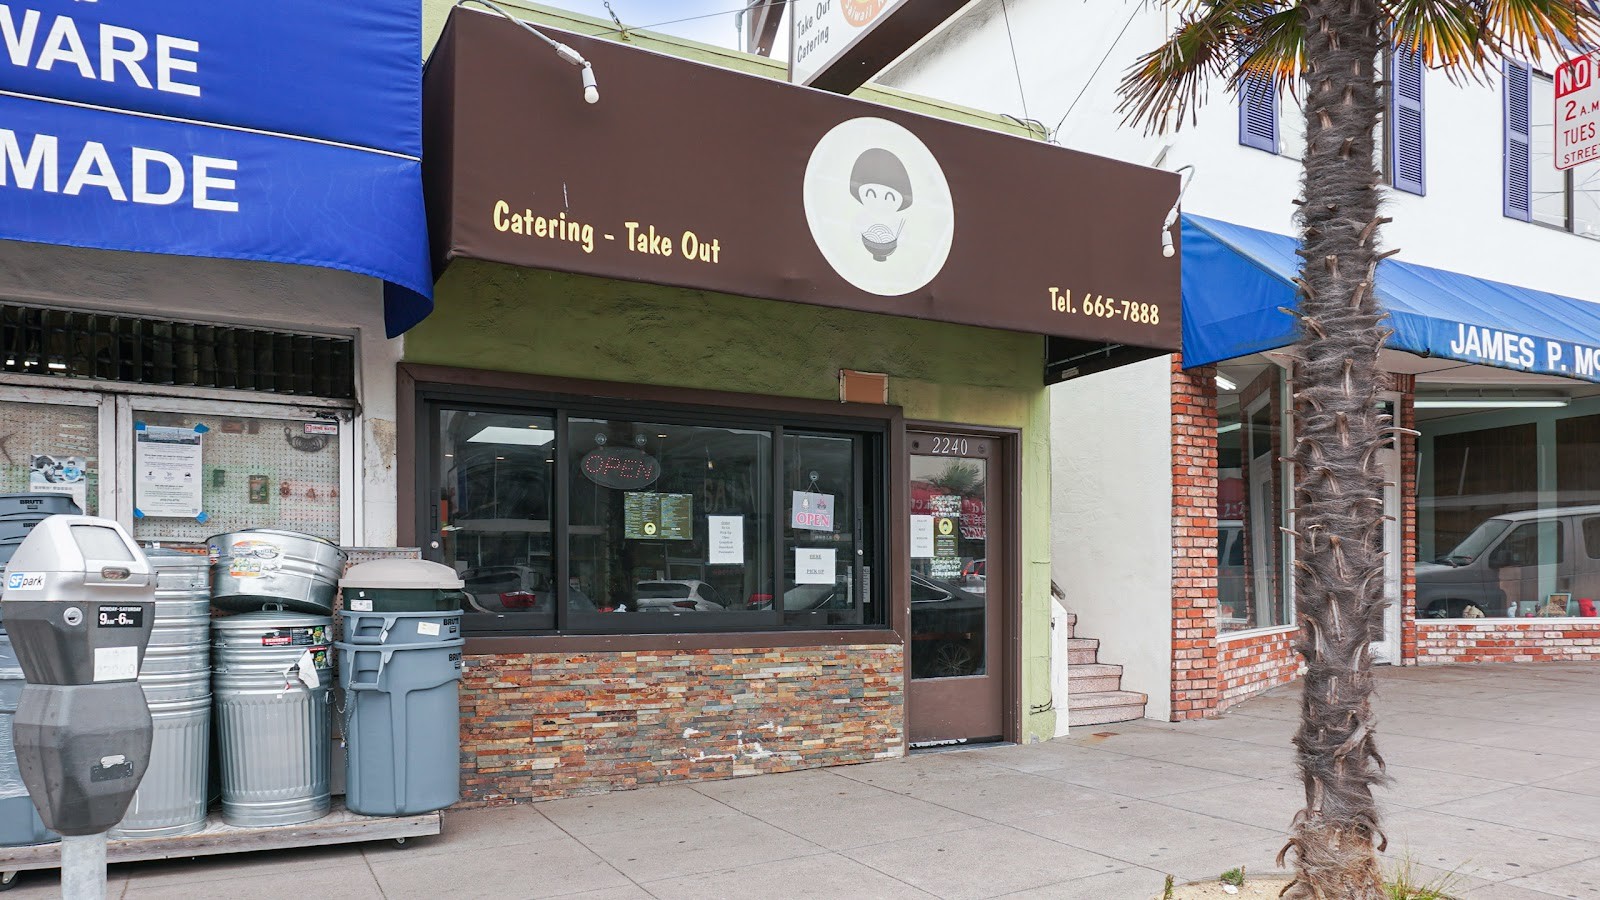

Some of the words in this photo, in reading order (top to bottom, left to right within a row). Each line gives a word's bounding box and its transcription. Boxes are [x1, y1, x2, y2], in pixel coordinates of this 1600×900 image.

[797, 16, 813, 38] Take
[797, 26, 829, 63] Catering
[1559, 59, 1589, 95] NO
[1565, 100, 1577, 121] 2
[1564, 121, 1596, 147] TUES
[1563, 143, 1600, 164] STREE
[0, 128, 239, 212] MADE
[493, 200, 594, 253] Catering
[625, 221, 673, 257] Take
[681, 231, 721, 263] Out
[1048, 287, 1077, 314] Tel.
[1083, 293, 1160, 325] 665-7888
[1450, 323, 1536, 368] JAMES
[1547, 341, 1567, 371] P.
[931, 436, 968, 455] 2240
[585, 455, 654, 480] OPEN
[796, 511, 830, 528] OPEN
